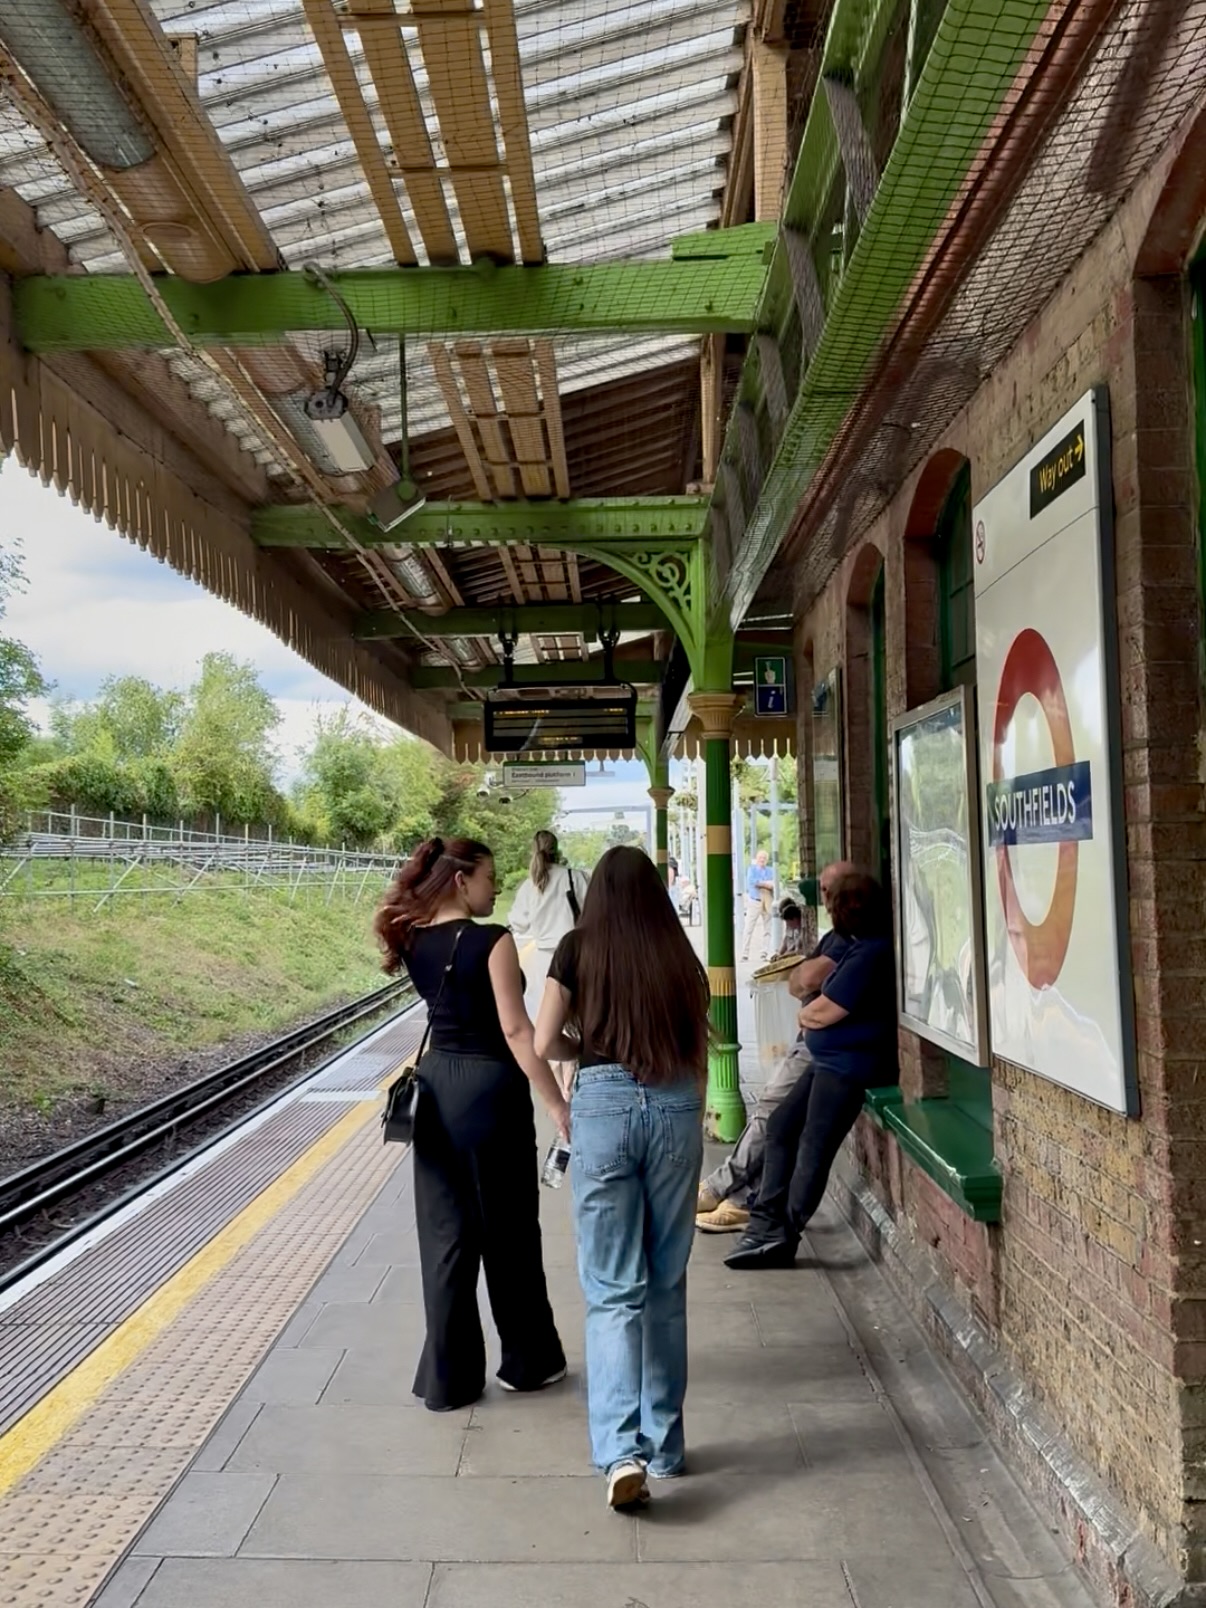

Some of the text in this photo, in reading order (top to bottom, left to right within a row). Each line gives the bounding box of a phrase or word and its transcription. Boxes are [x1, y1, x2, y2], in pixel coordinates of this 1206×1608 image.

[1039, 444, 1074, 494] Way out
[994, 780, 1077, 831] SOUTHFIELDS
